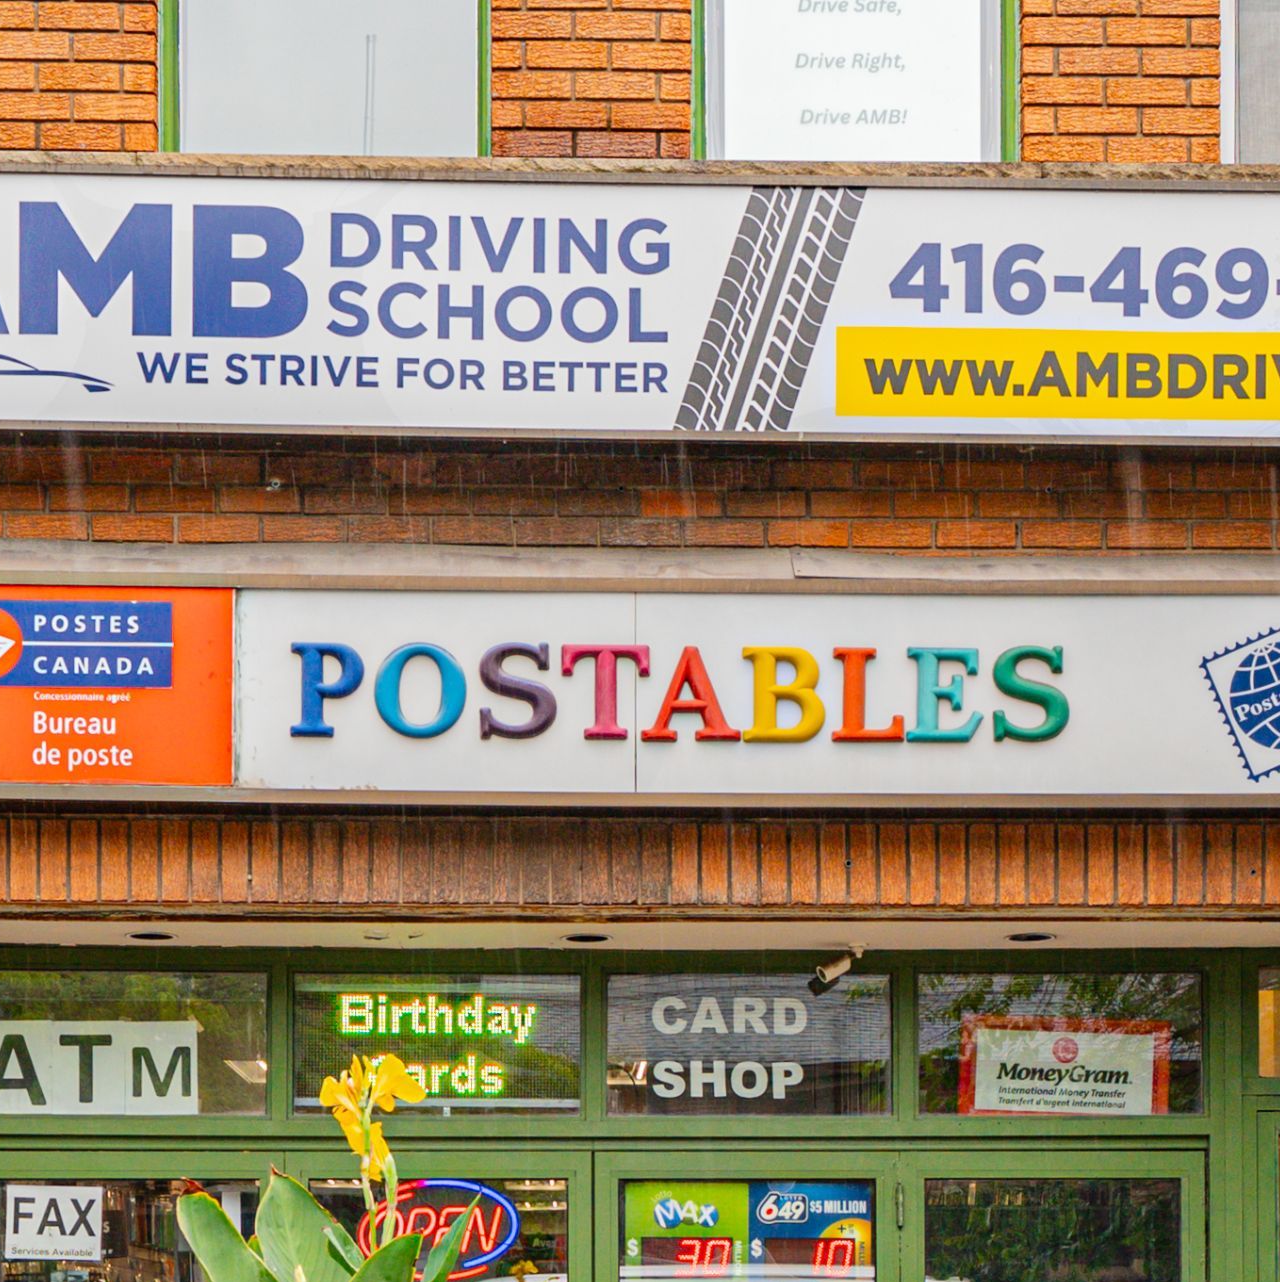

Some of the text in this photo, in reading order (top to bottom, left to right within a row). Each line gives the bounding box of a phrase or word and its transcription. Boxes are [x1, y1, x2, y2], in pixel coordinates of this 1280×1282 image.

[795, 52, 906, 73] Drive Right,
[800, 109, 908, 125] Drive AMB!
[330, 212, 670, 275] DRIVING
[327, 280, 668, 343] SCHOOL
[136, 352, 668, 393] WE STRIVE FOR BETTER
[34, 615, 140, 634] POSTES
[33, 656, 154, 675] CANADA
[33, 691, 104, 702] Concessionnaire
[289, 641, 1072, 744] POSTABLES
[33, 711, 116, 735] Bureau
[32, 741, 133, 772] de poste
[340, 994, 536, 1044] Birthday
[651, 996, 808, 1035] CARD
[652, 1061, 805, 1099] SHOP
[999, 1086, 1126, 1098] International Money Transfer
[999, 1096, 1034, 1105] Transfert
[12, 1197, 96, 1237] FAX
[654, 1199, 718, 1229] MAX
[810, 1201, 866, 1214] $5 MILLION
[11, 1247, 93, 1257] Services Available
[674, 1239, 730, 1277] 30
[812, 1240, 853, 1276] 10
